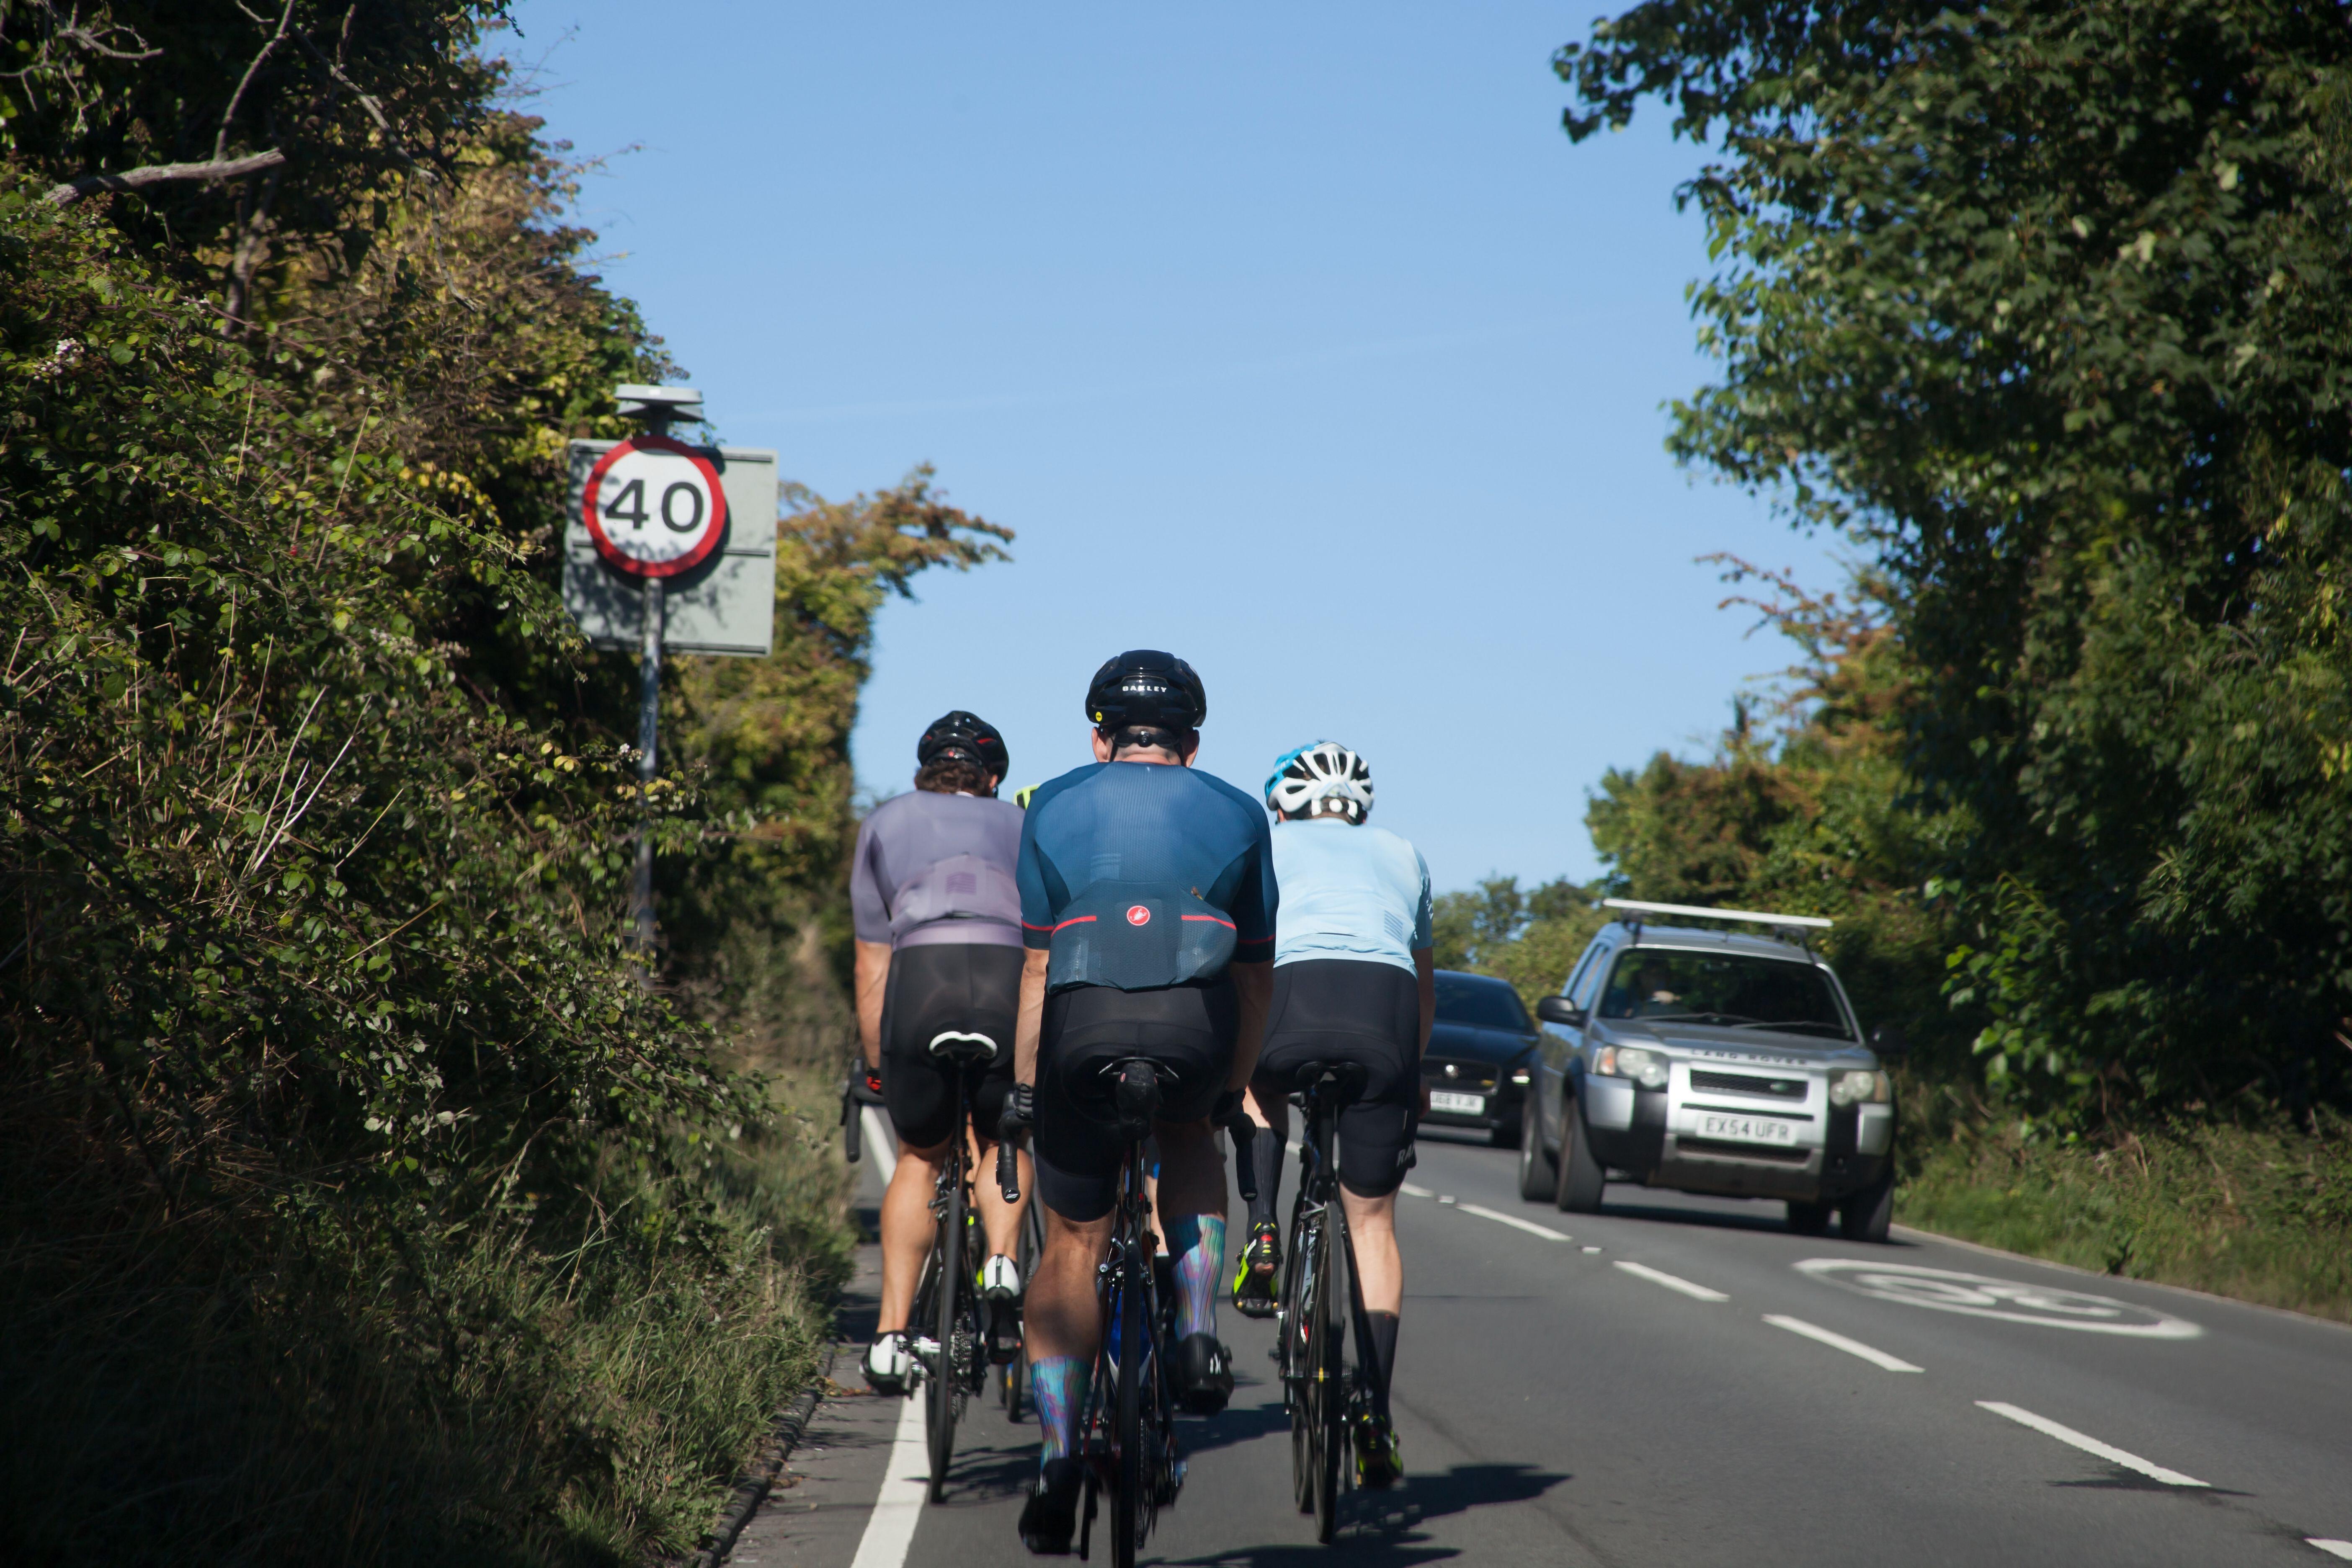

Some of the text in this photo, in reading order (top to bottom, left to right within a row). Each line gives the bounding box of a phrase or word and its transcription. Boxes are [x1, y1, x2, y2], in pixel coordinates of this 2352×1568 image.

[605, 479, 704, 533] 40
[1690, 1048, 1808, 1065] LAND ROVER
[1706, 1117, 1750, 1136] EX54
